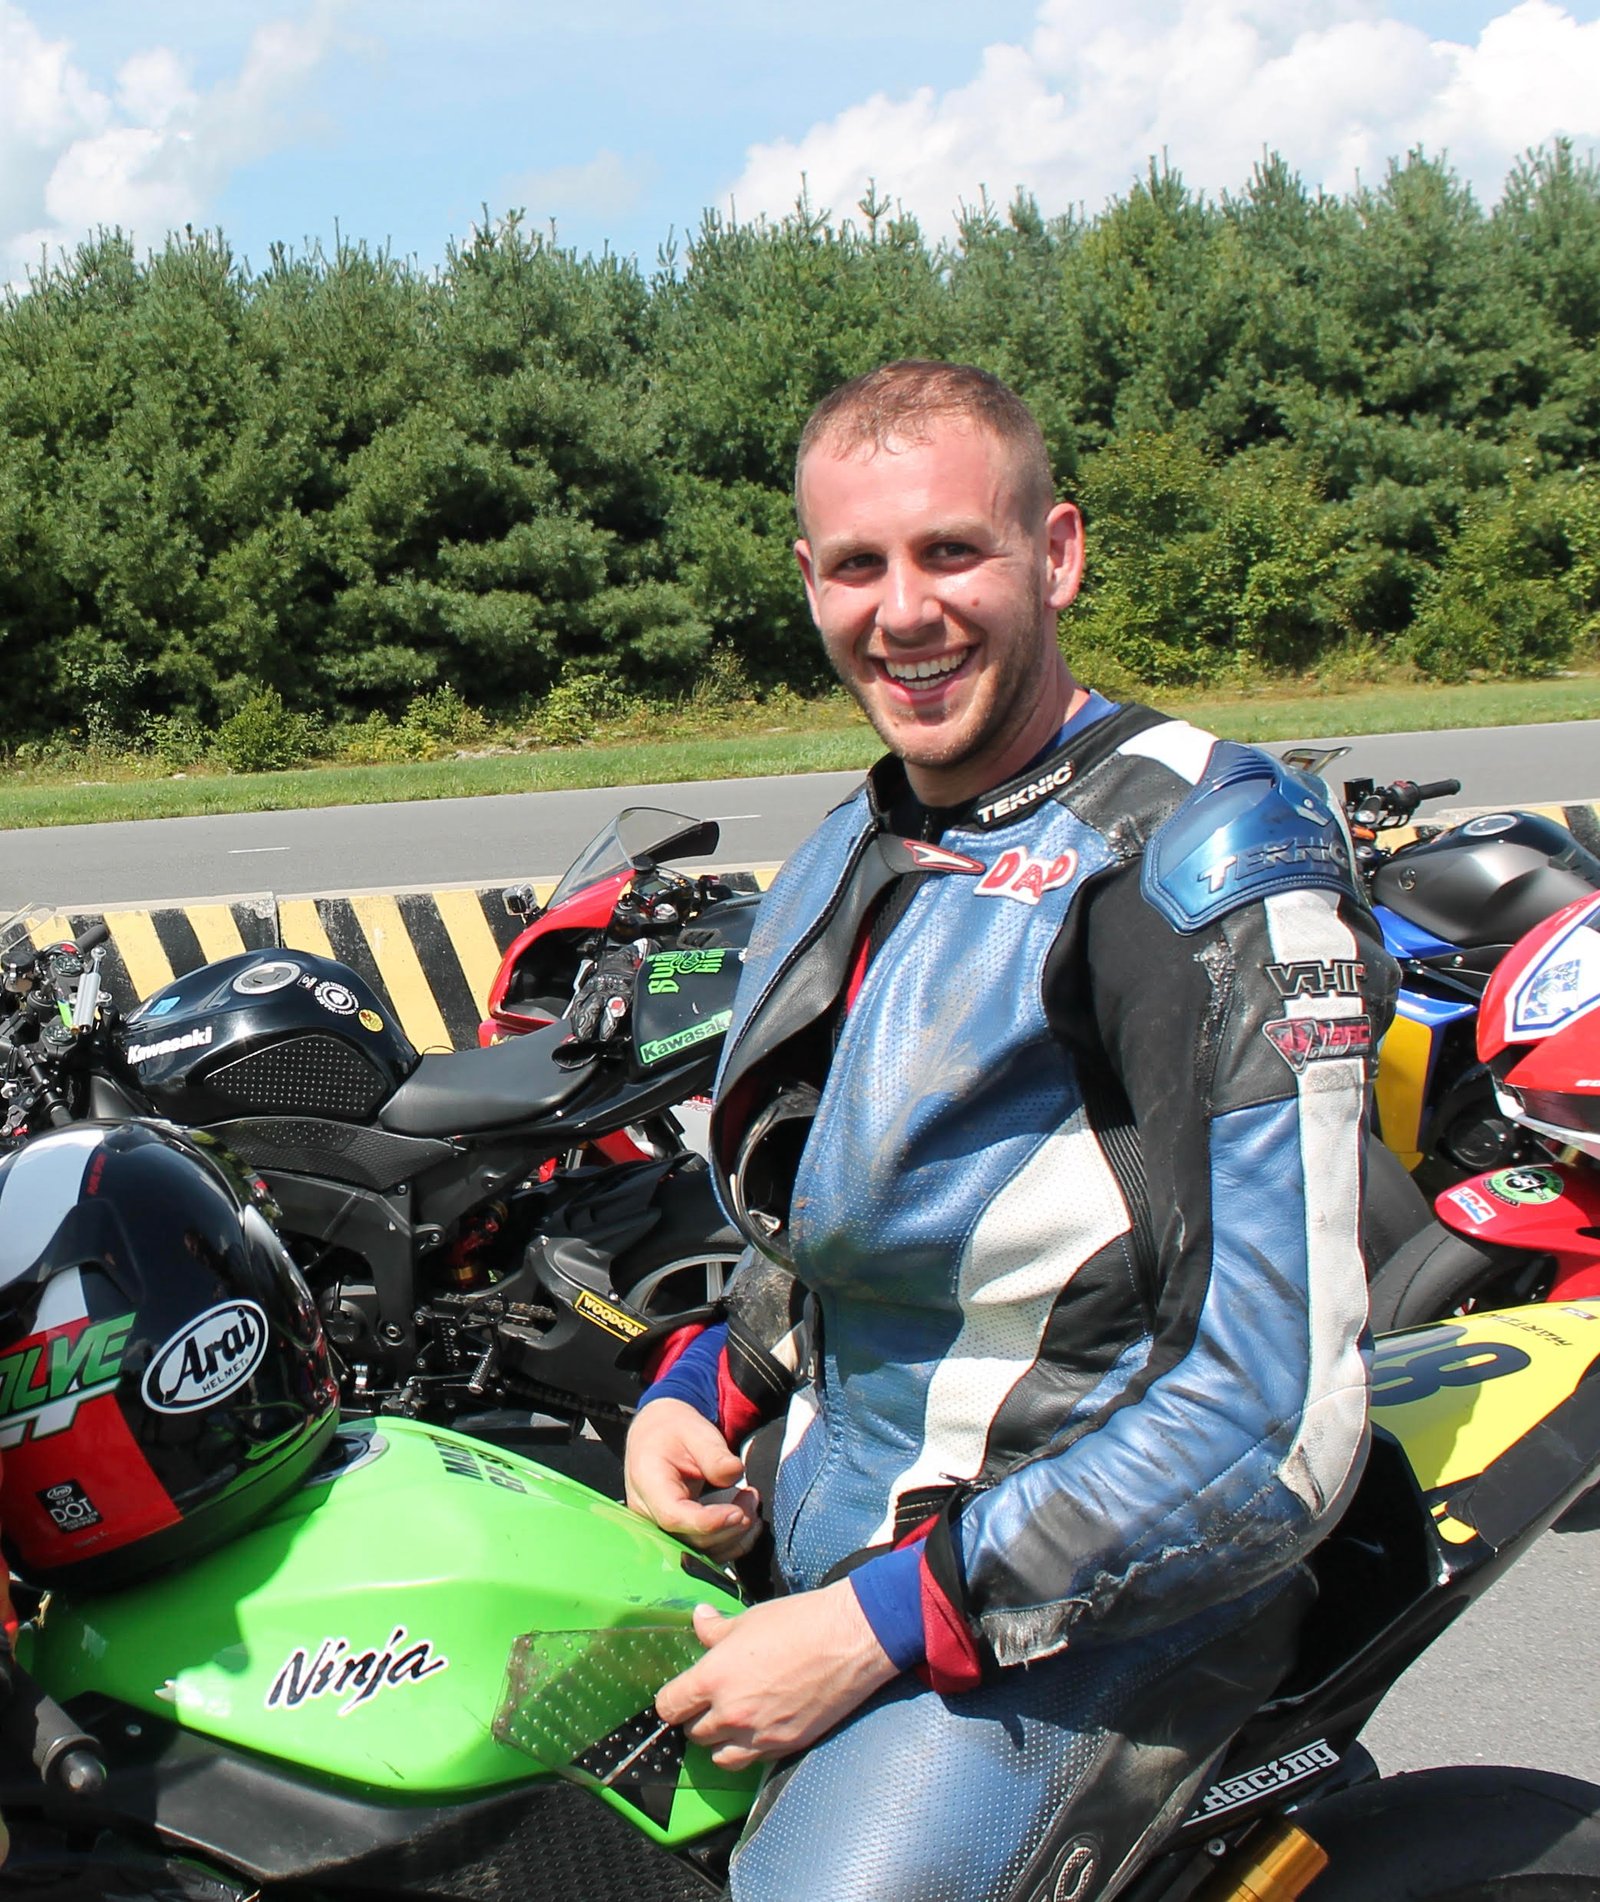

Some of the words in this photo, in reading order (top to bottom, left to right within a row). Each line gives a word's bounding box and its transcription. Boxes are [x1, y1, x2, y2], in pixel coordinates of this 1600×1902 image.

[977, 765, 1073, 823] TEKNIC
[127, 1026, 212, 1065] Kawasaki
[162, 1306, 256, 1404] Arai
[201, 1359, 247, 1394] HELMET
[50, 1497, 91, 1523] DOT
[269, 1630, 444, 1713] Ninja
